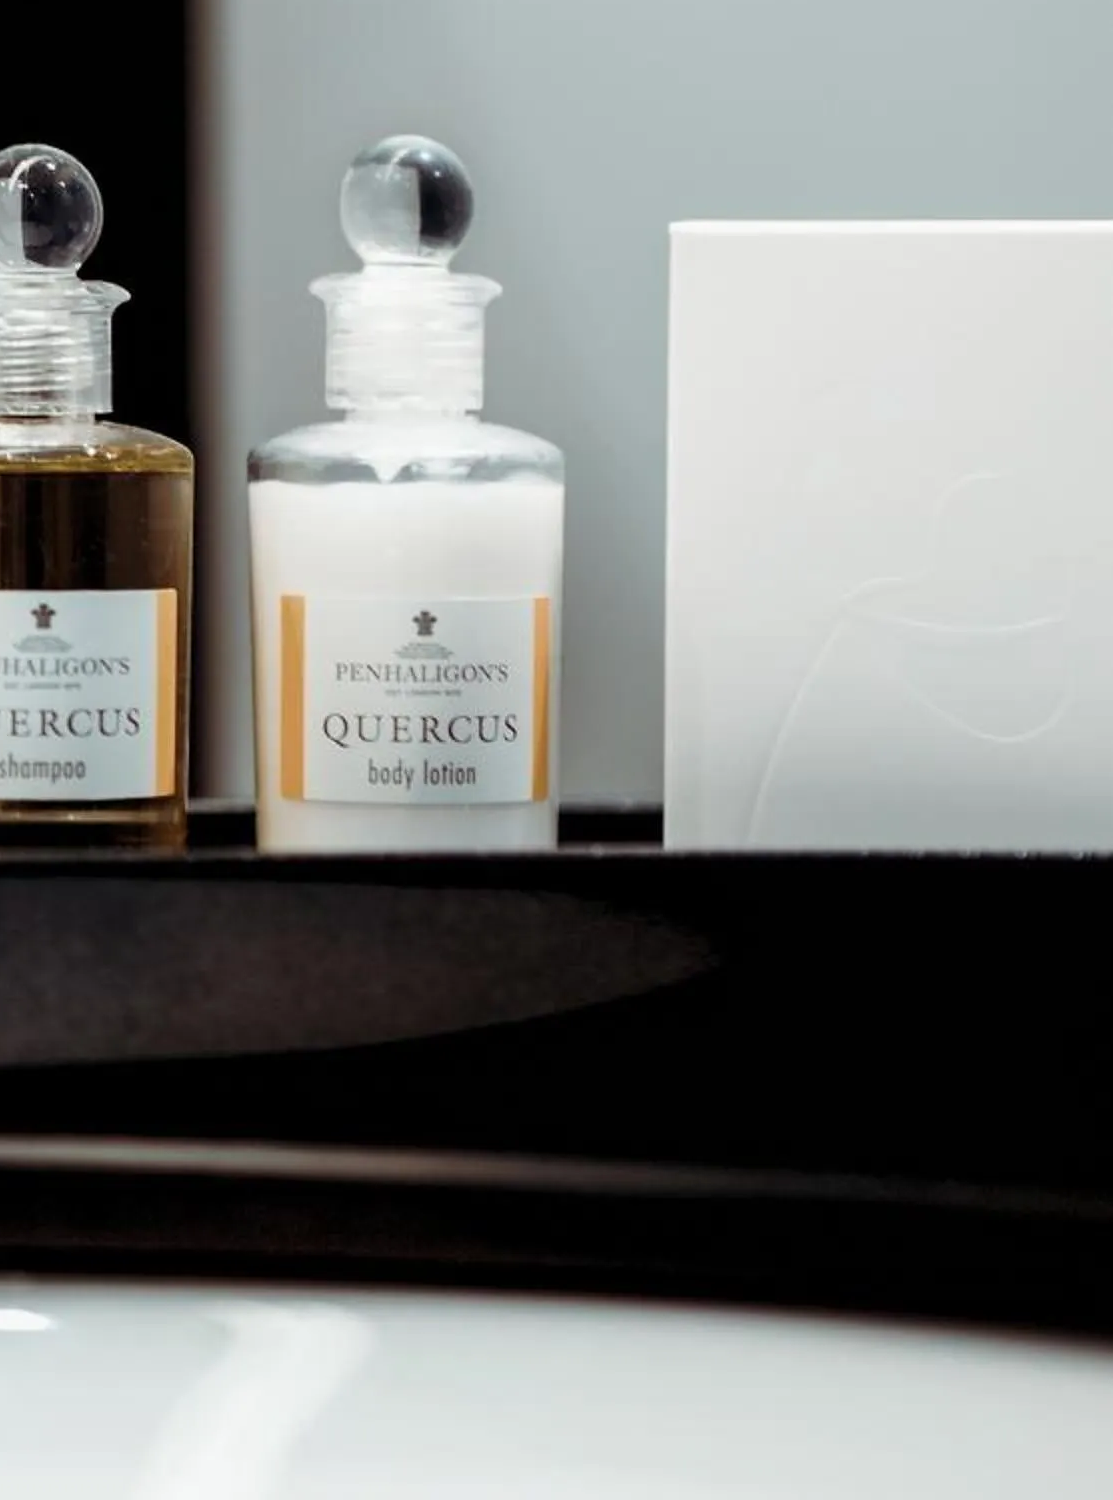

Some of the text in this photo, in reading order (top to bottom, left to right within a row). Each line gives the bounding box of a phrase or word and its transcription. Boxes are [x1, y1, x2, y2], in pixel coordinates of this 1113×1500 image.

[335, 663, 509, 684] PENHALIGON'S
[323, 712, 519, 749] QUERCUS
[367, 758, 477, 791] body lotion
